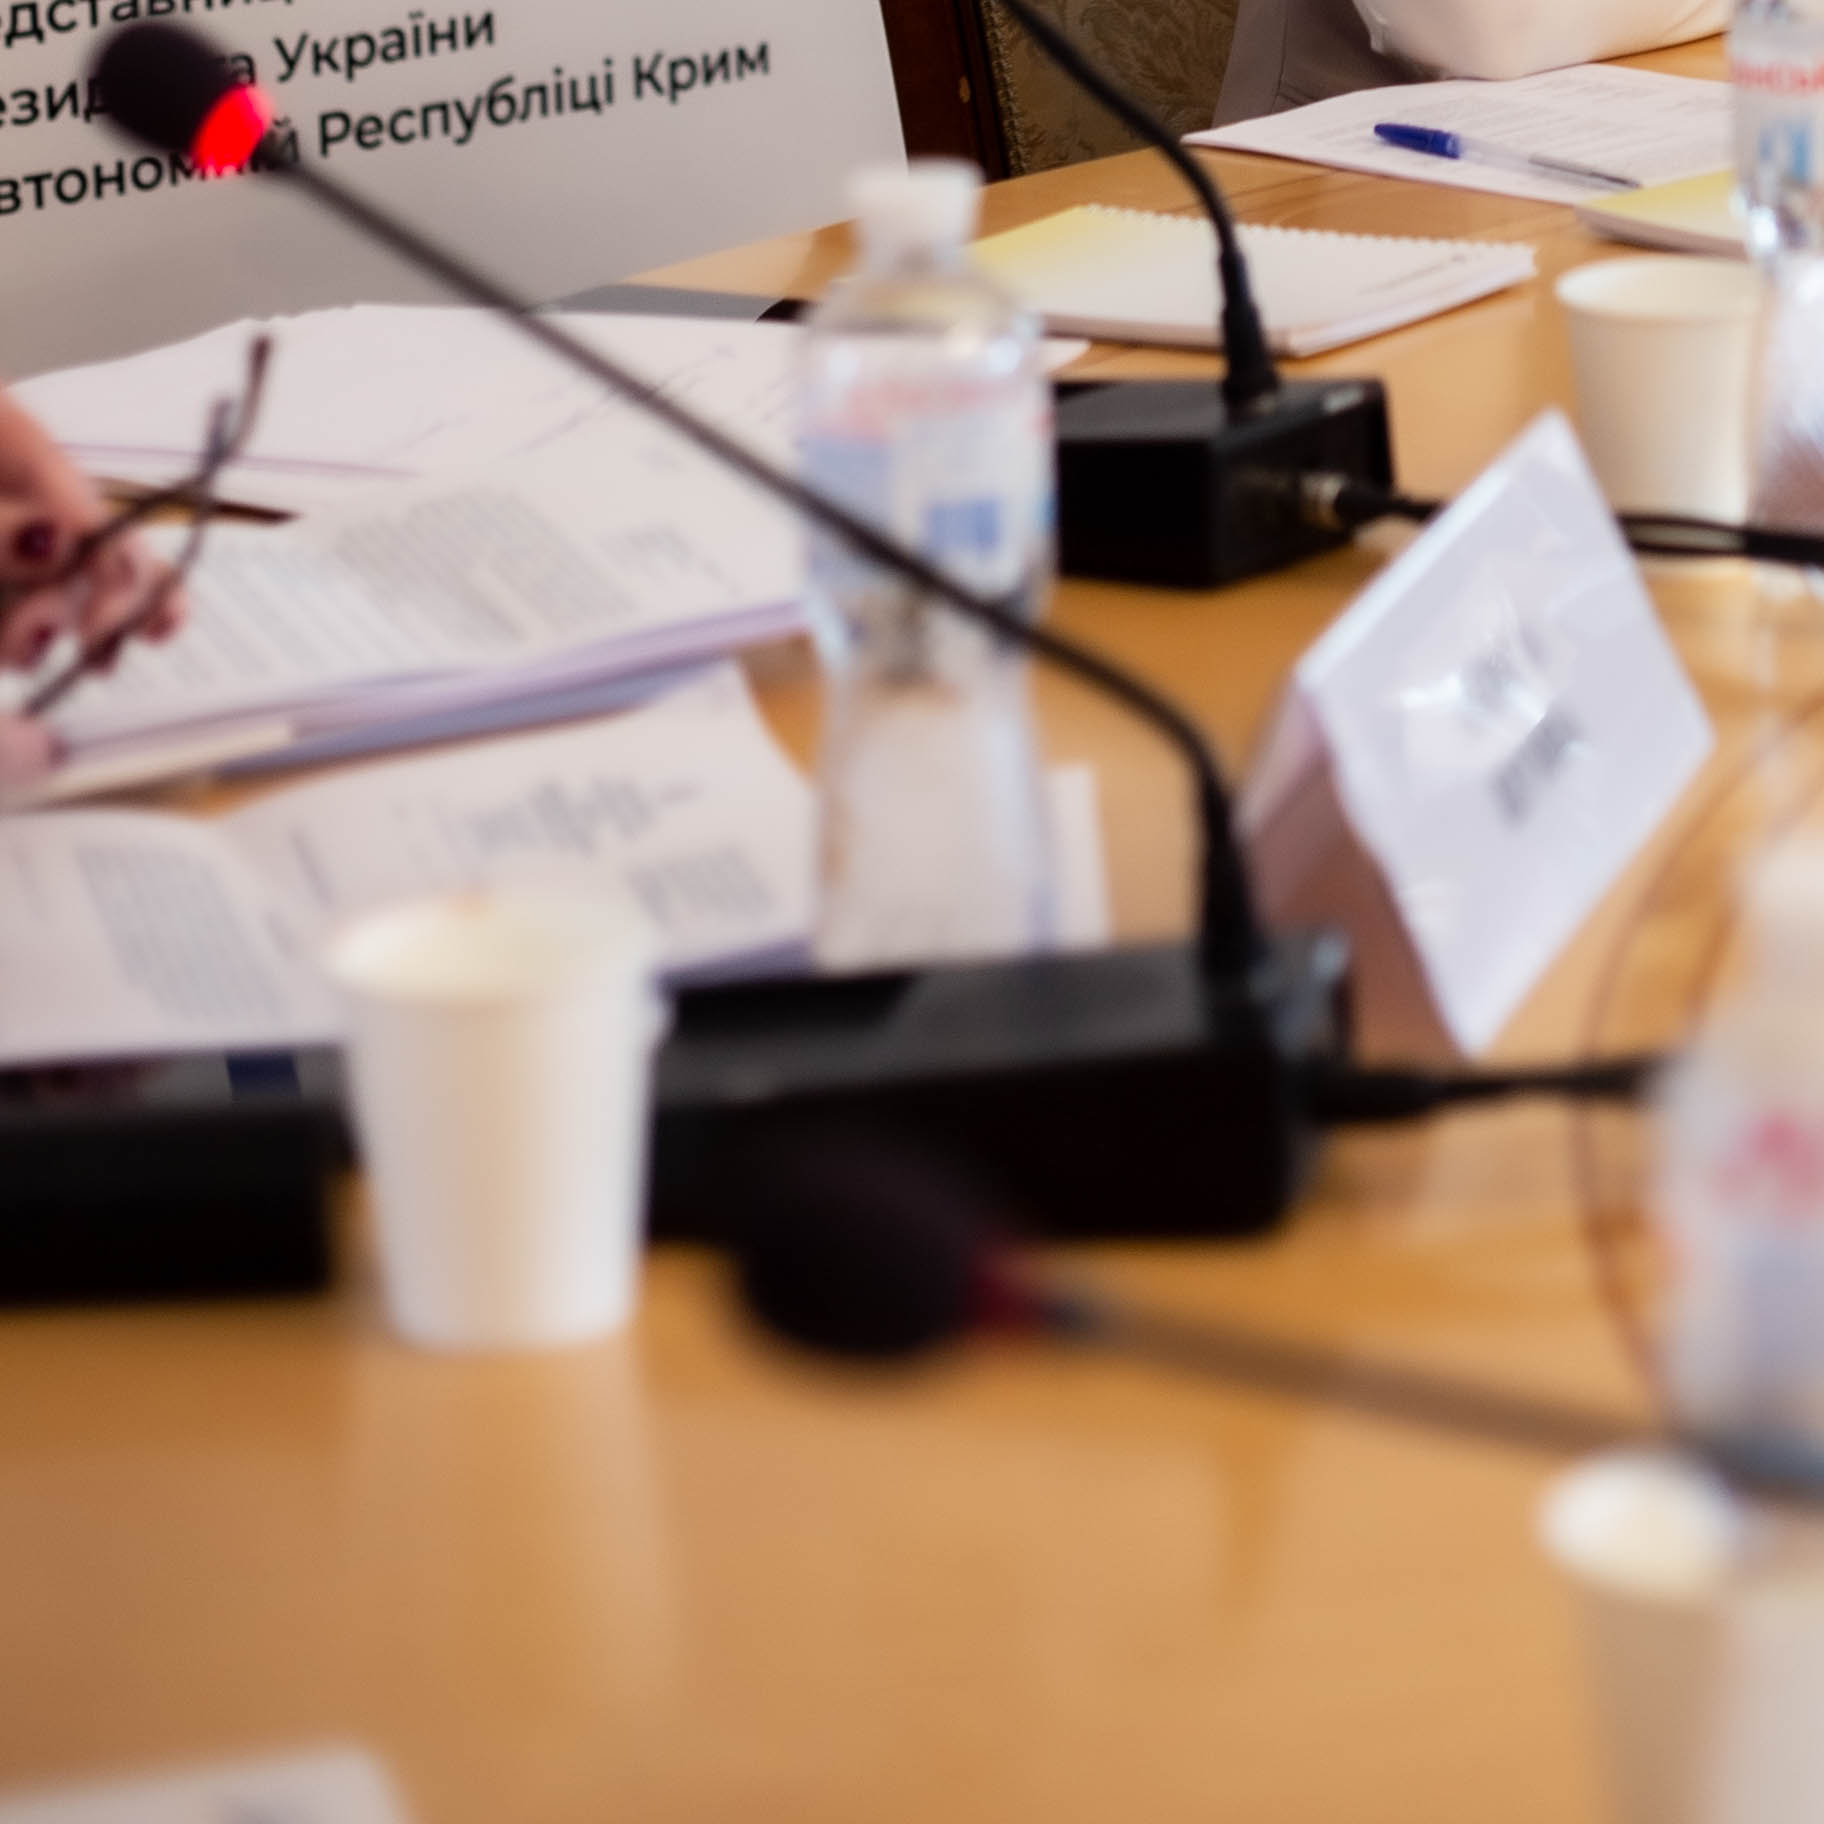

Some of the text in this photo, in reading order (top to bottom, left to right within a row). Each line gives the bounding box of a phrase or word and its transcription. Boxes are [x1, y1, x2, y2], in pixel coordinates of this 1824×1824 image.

[273, 8, 497, 85] України
[318, 55, 616, 156] Республіці
[632, 40, 770, 102] Крим
